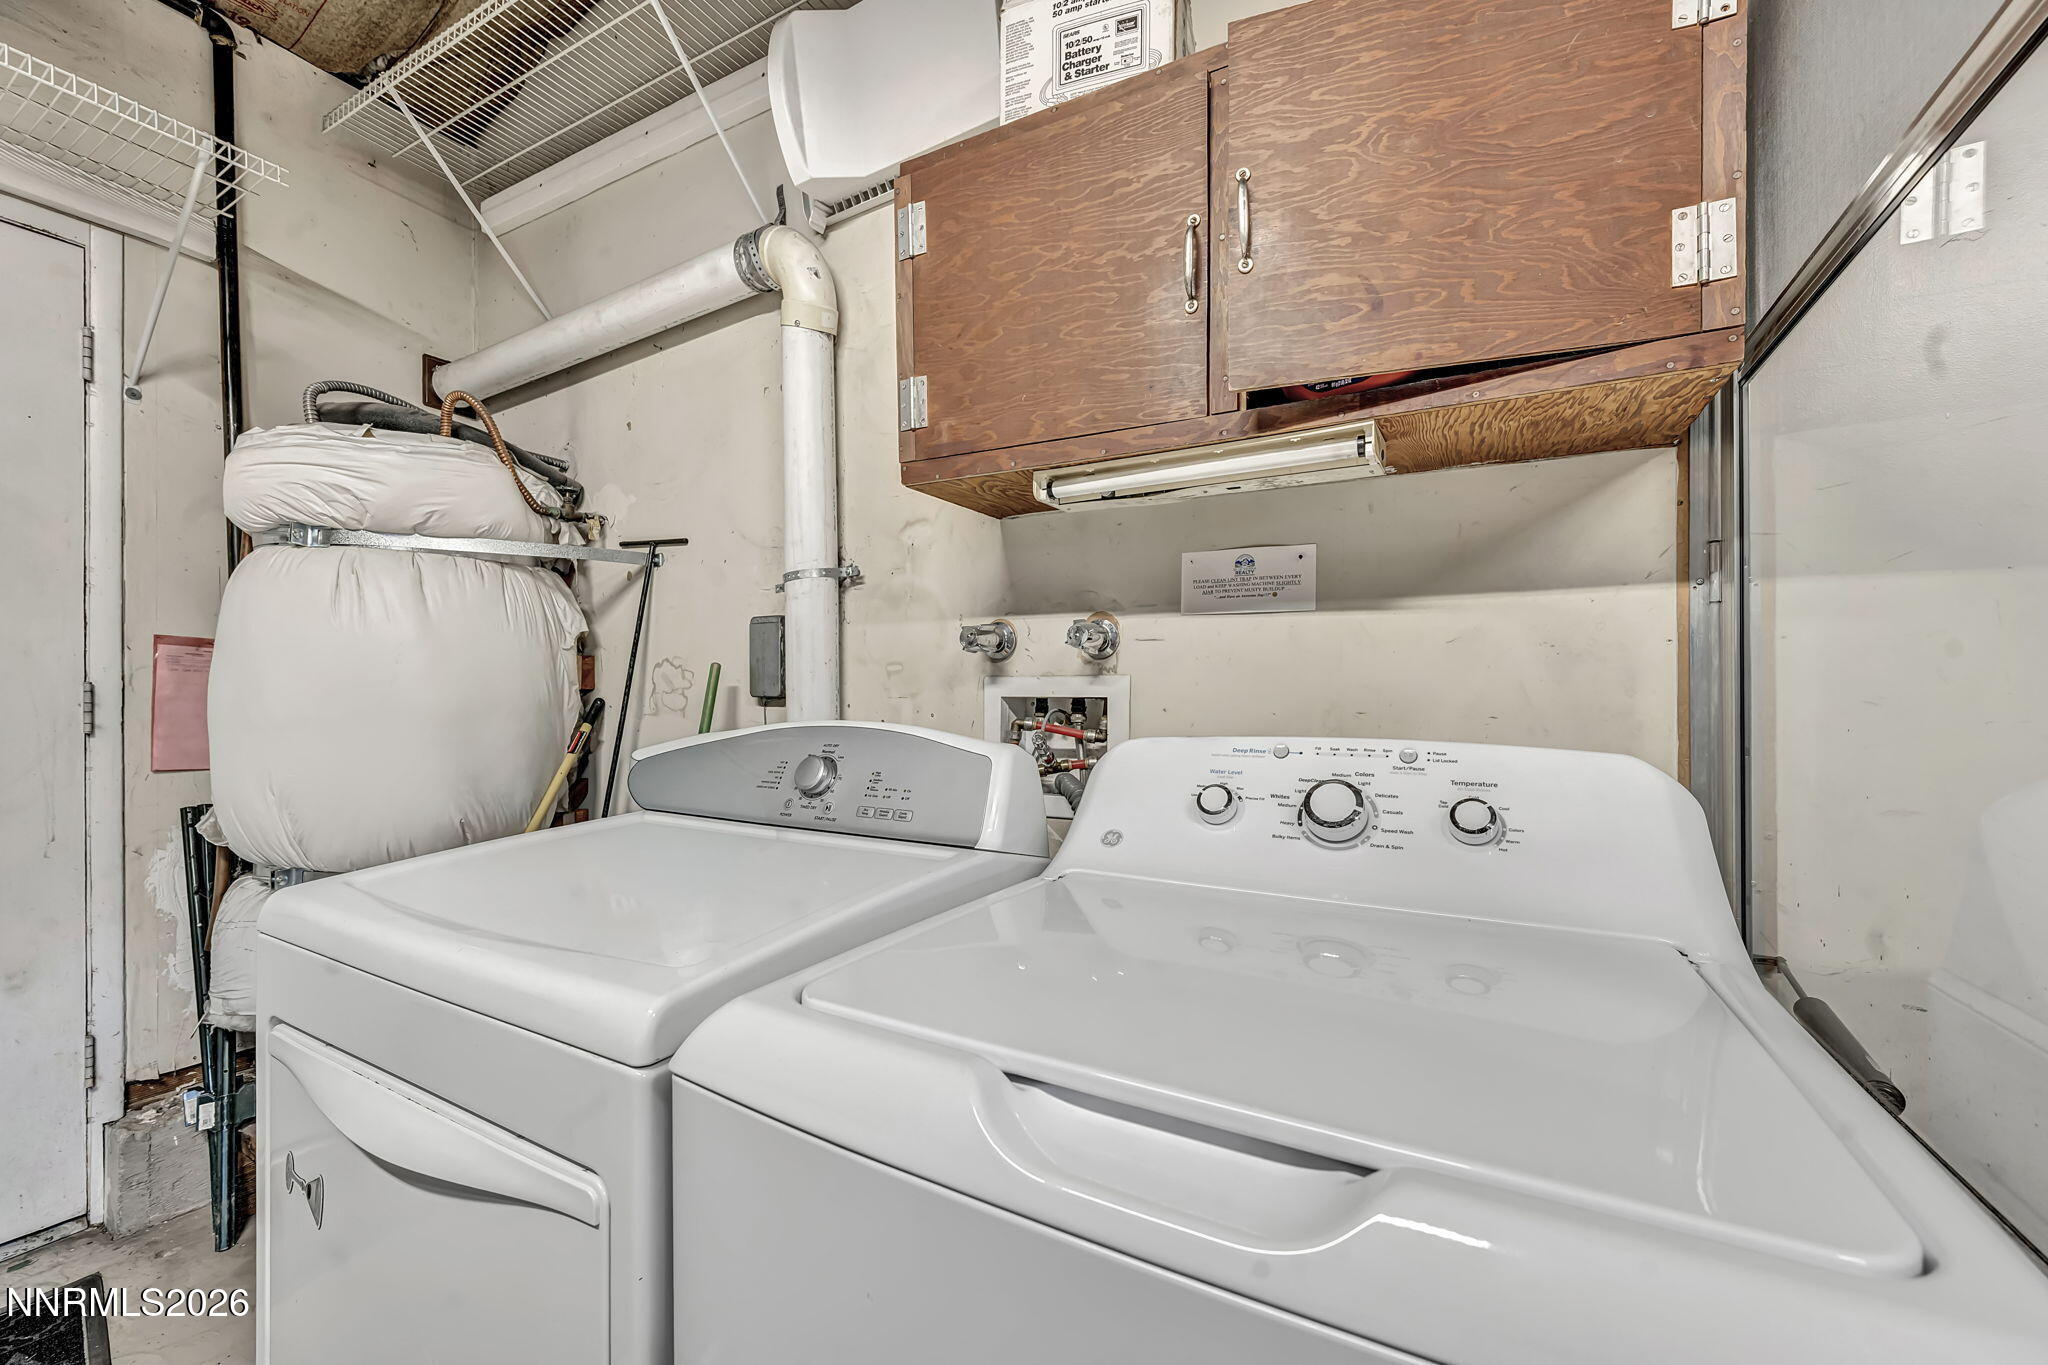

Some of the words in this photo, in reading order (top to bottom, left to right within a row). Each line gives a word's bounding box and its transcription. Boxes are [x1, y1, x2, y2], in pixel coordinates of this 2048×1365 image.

[1052, 8, 1063, 18] 50
[1064, 4, 1083, 14] amp
[1064, 44, 1102, 61] Battery
[1062, 54, 1103, 72] Charger
[1064, 71, 1073, 81] &
[1074, 63, 1110, 79] Starter
[1232, 747, 1249, 755] Deep
[1354, 770, 1376, 778] Colors
[1450, 780, 1499, 789] Temperature
[1380, 827, 1398, 835] Speed
